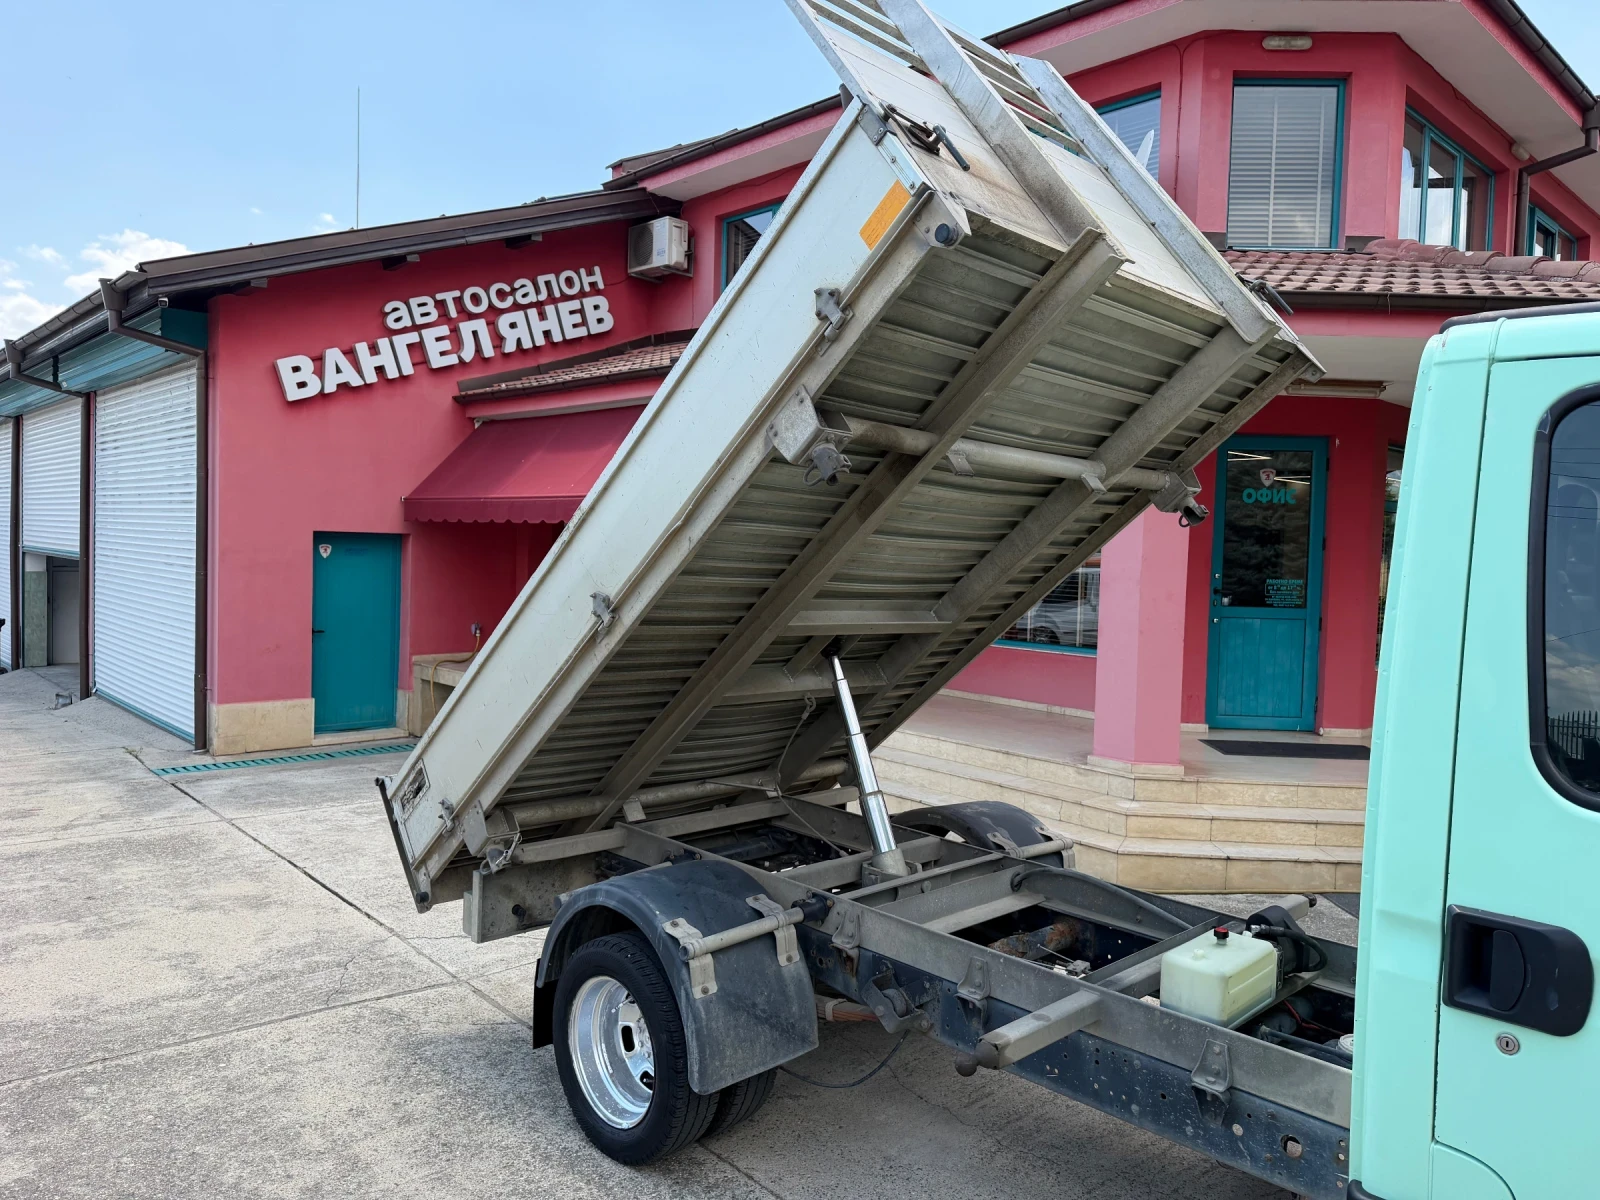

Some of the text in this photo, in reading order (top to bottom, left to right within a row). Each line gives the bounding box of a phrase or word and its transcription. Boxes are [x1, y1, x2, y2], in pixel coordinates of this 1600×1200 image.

[383, 265, 605, 330] автосалон
[274, 295, 615, 402] ВАНГЕЛ ЯНЕВ
[1242, 487, 1296, 504] ОФИС
